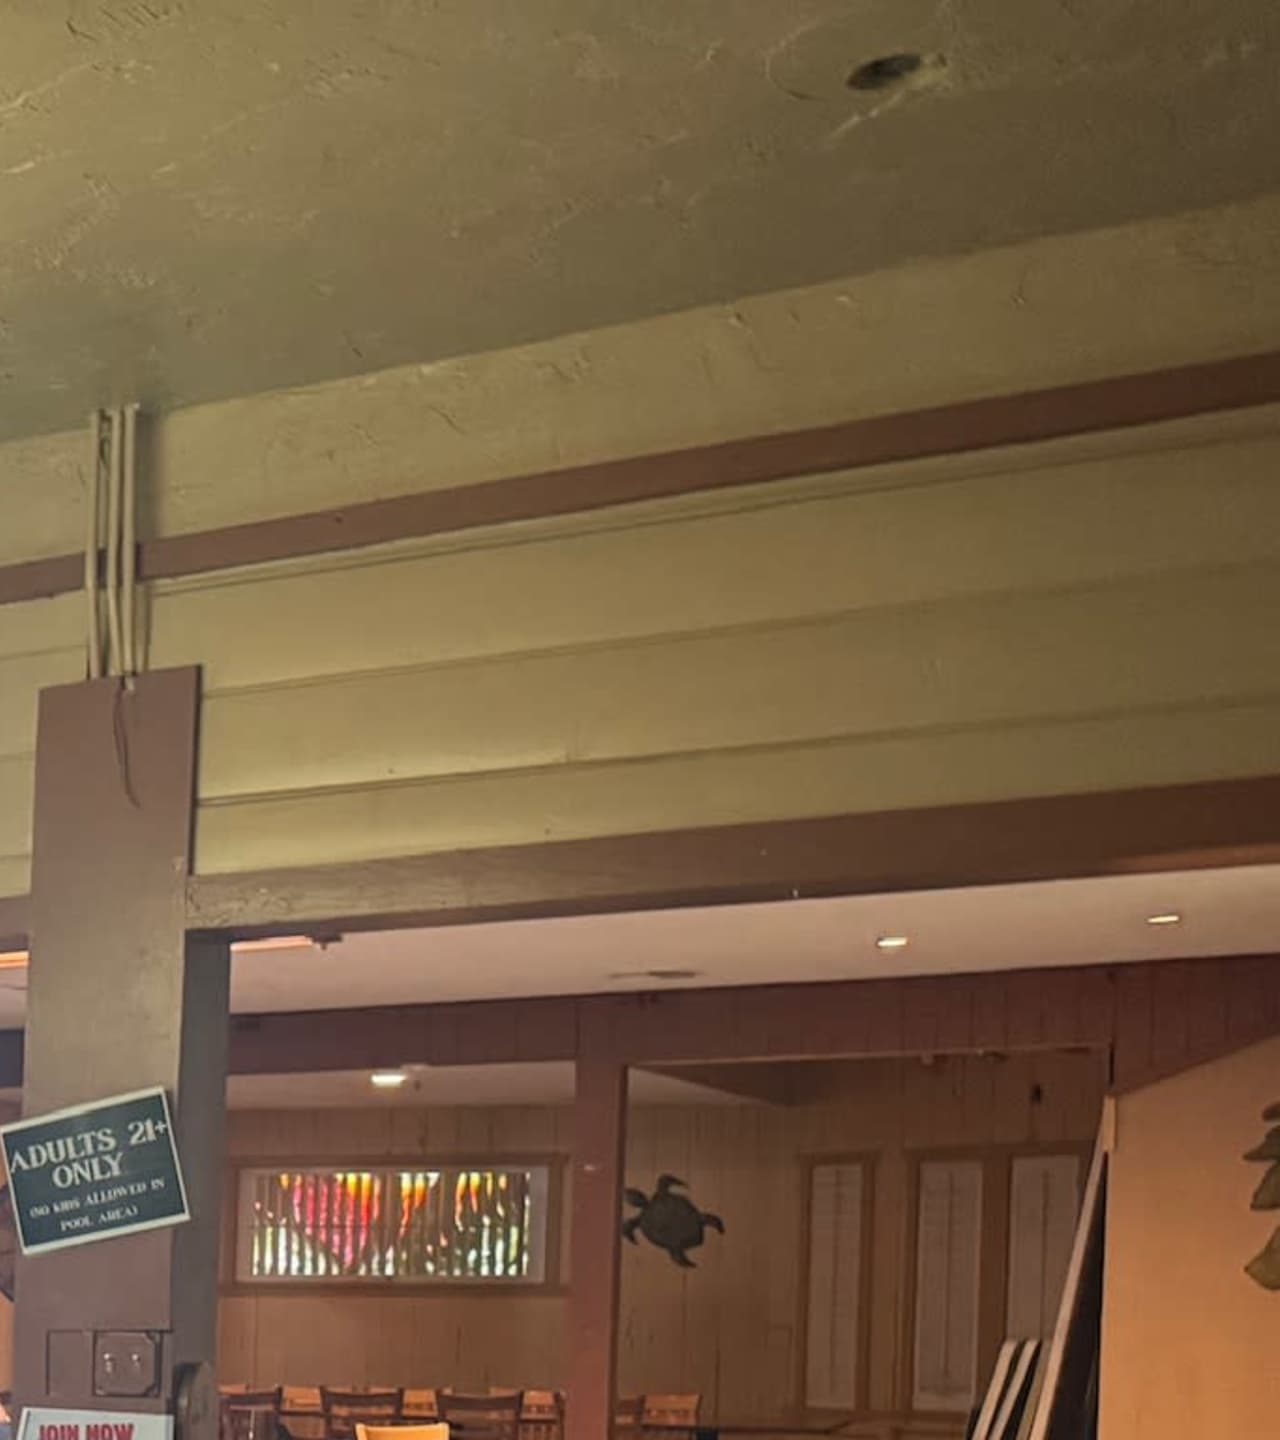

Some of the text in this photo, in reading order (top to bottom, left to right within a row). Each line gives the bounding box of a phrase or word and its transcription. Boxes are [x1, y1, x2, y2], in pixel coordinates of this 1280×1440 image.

[10, 1118, 168, 1174] ADULTS 21+
[52, 1152, 124, 1189] ONLY
[29, 1178, 165, 1219] (NO KIDS ALLOWED IN
[60, 1204, 139, 1232] POOL AREA)
